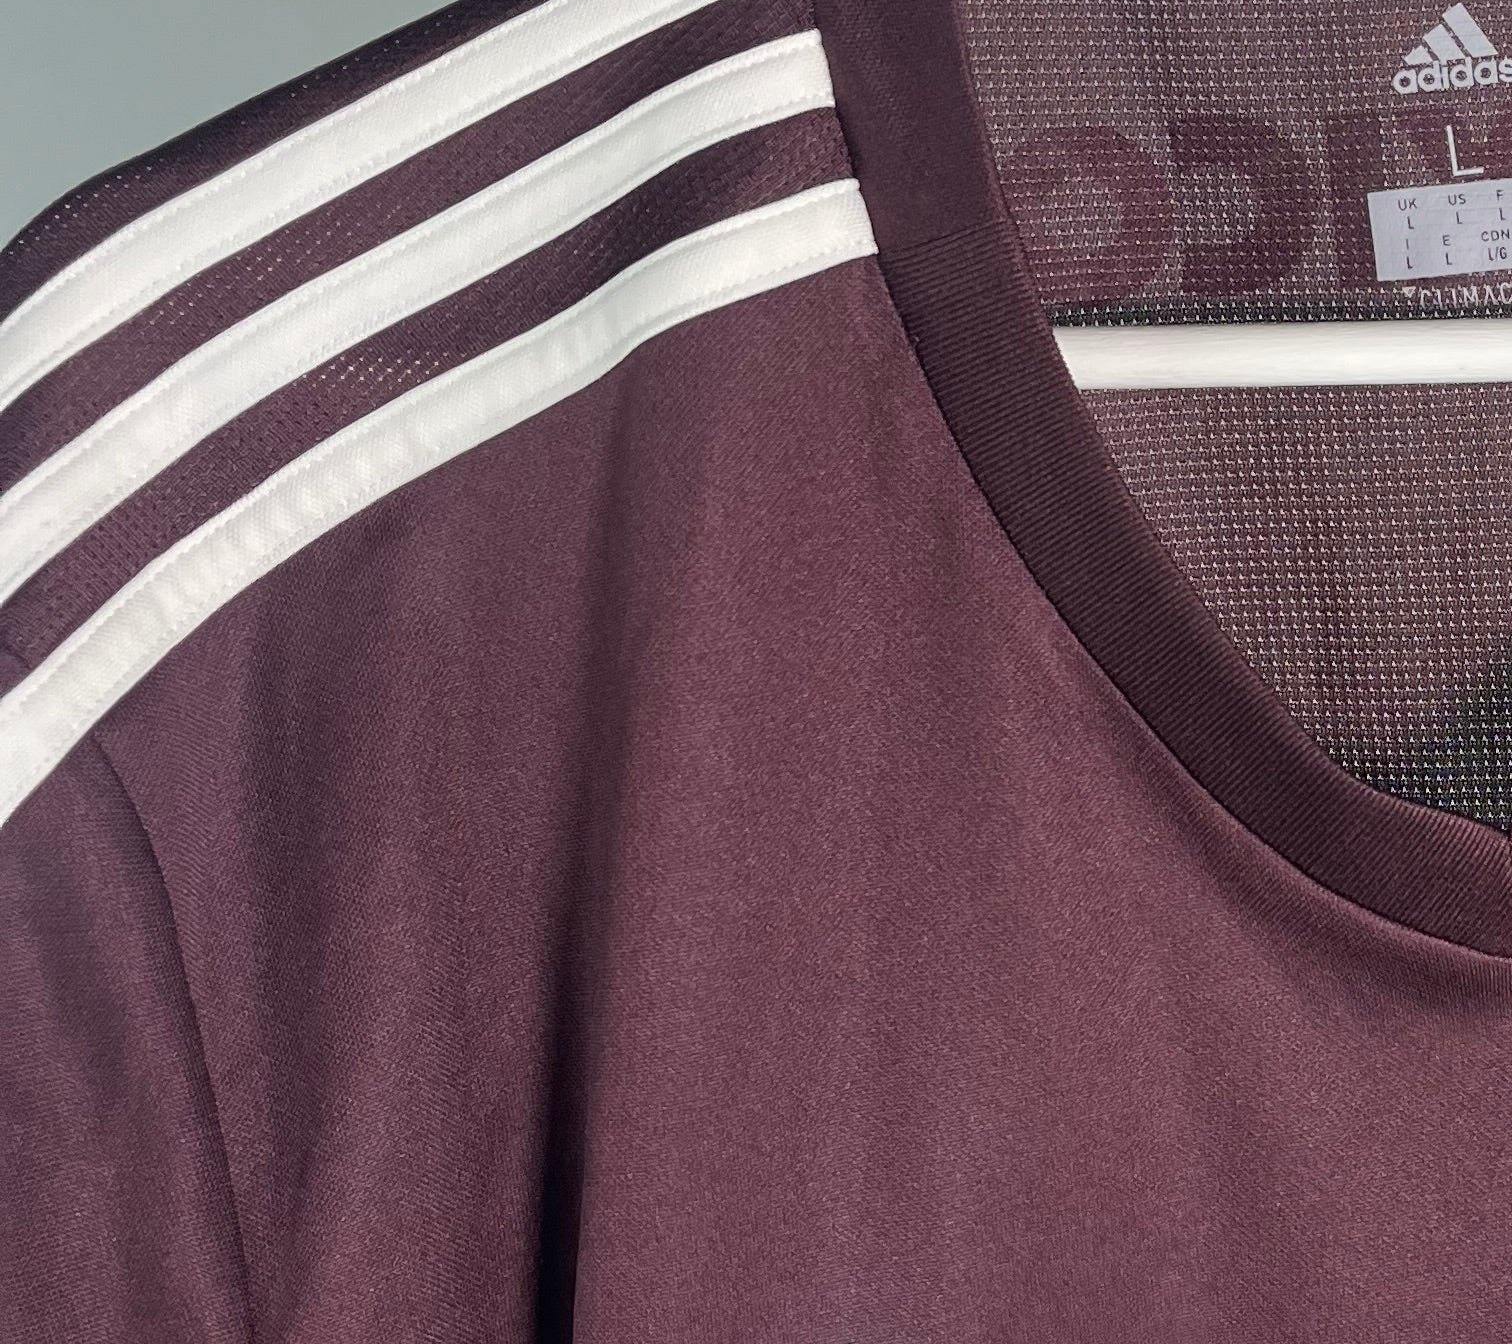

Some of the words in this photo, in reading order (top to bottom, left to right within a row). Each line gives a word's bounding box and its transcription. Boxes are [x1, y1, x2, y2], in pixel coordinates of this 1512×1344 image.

[1446, 124, 1484, 177] L
[1397, 198, 1418, 211] UK
[1447, 193, 1467, 206] US
[1496, 189, 1504, 200] F
[1407, 216, 1415, 230] L
[1456, 211, 1464, 225] L
[1499, 207, 1507, 221] L
[1442, 234, 1451, 246] E
[1481, 228, 1511, 242] CDN
[1406, 256, 1414, 269] L
[1446, 252, 1453, 265] L
[1487, 246, 1508, 262] L/G
